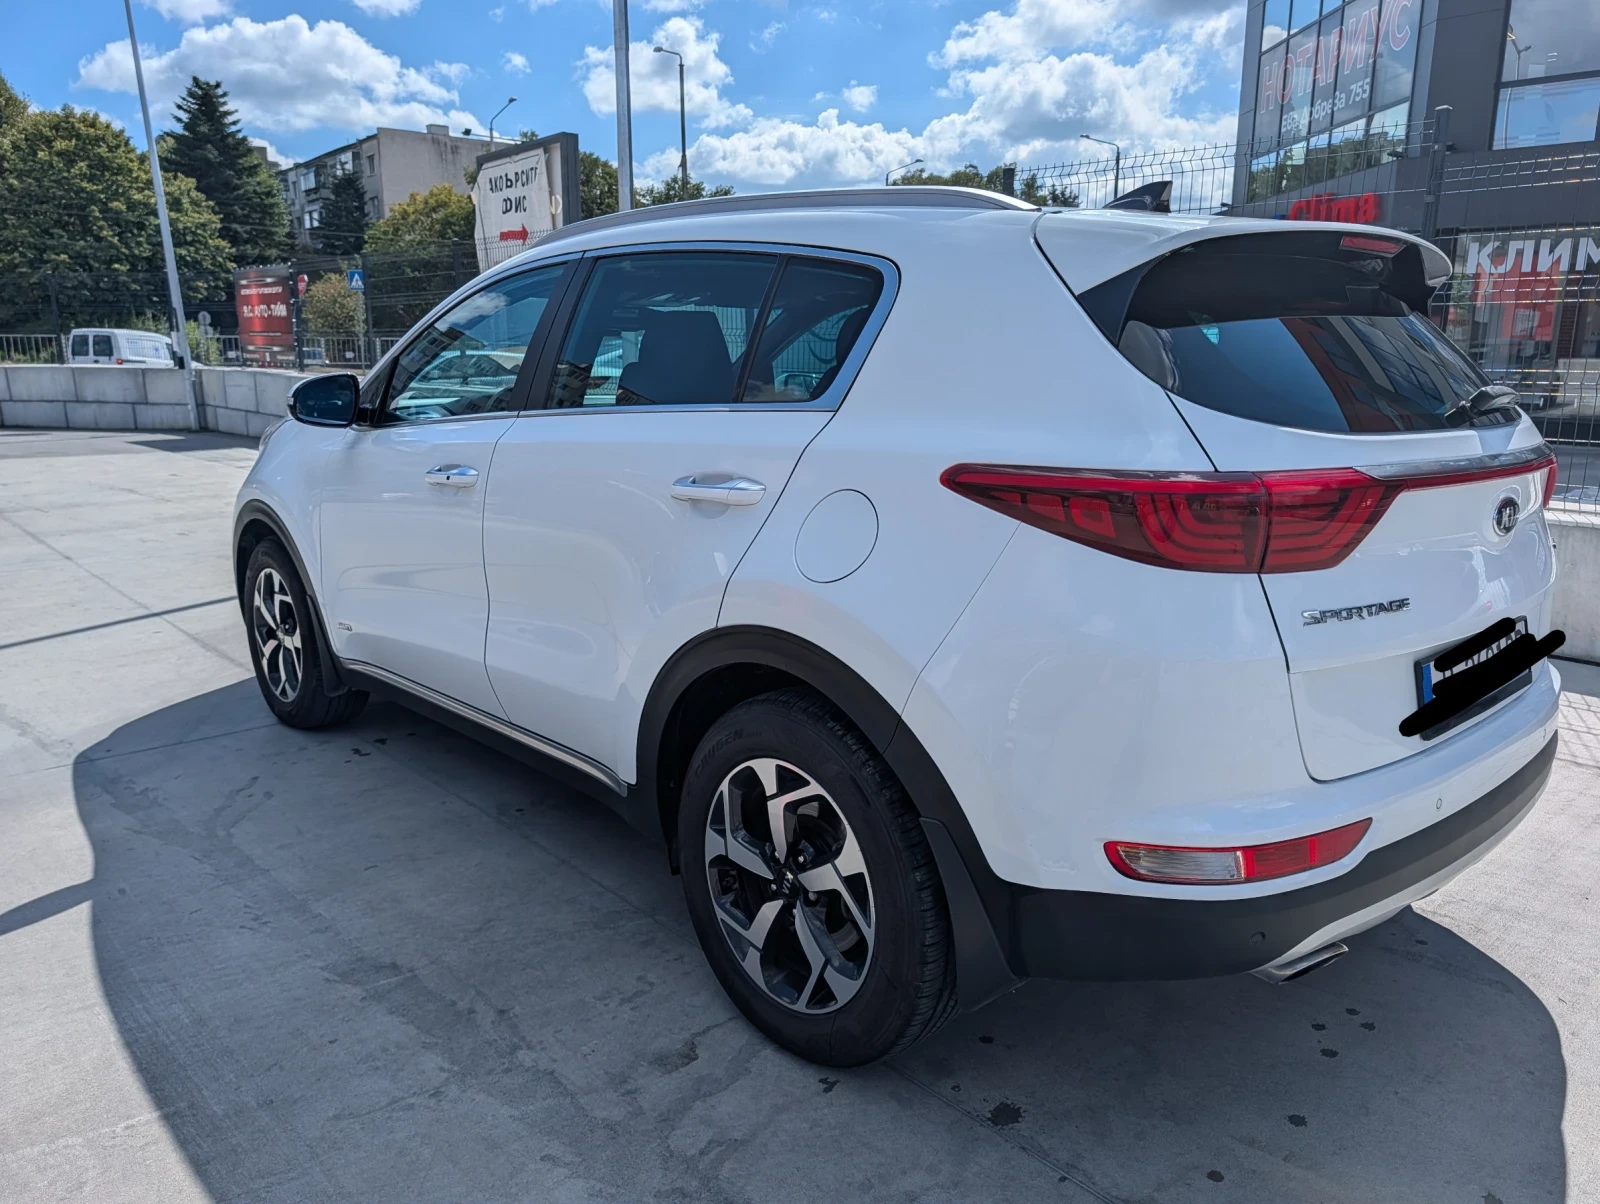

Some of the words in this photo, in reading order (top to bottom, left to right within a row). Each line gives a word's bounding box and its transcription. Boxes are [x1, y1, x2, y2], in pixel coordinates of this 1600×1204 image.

[1260, 0, 1412, 114] НОТАРИУС
[1348, 78, 1371, 104] 755
[1466, 237, 1600, 275] КЛИМ
[1500, 504, 1519, 529] KIA
[1302, 597, 1411, 627] SPORTAGE
[781, 870, 794, 895] KIA
